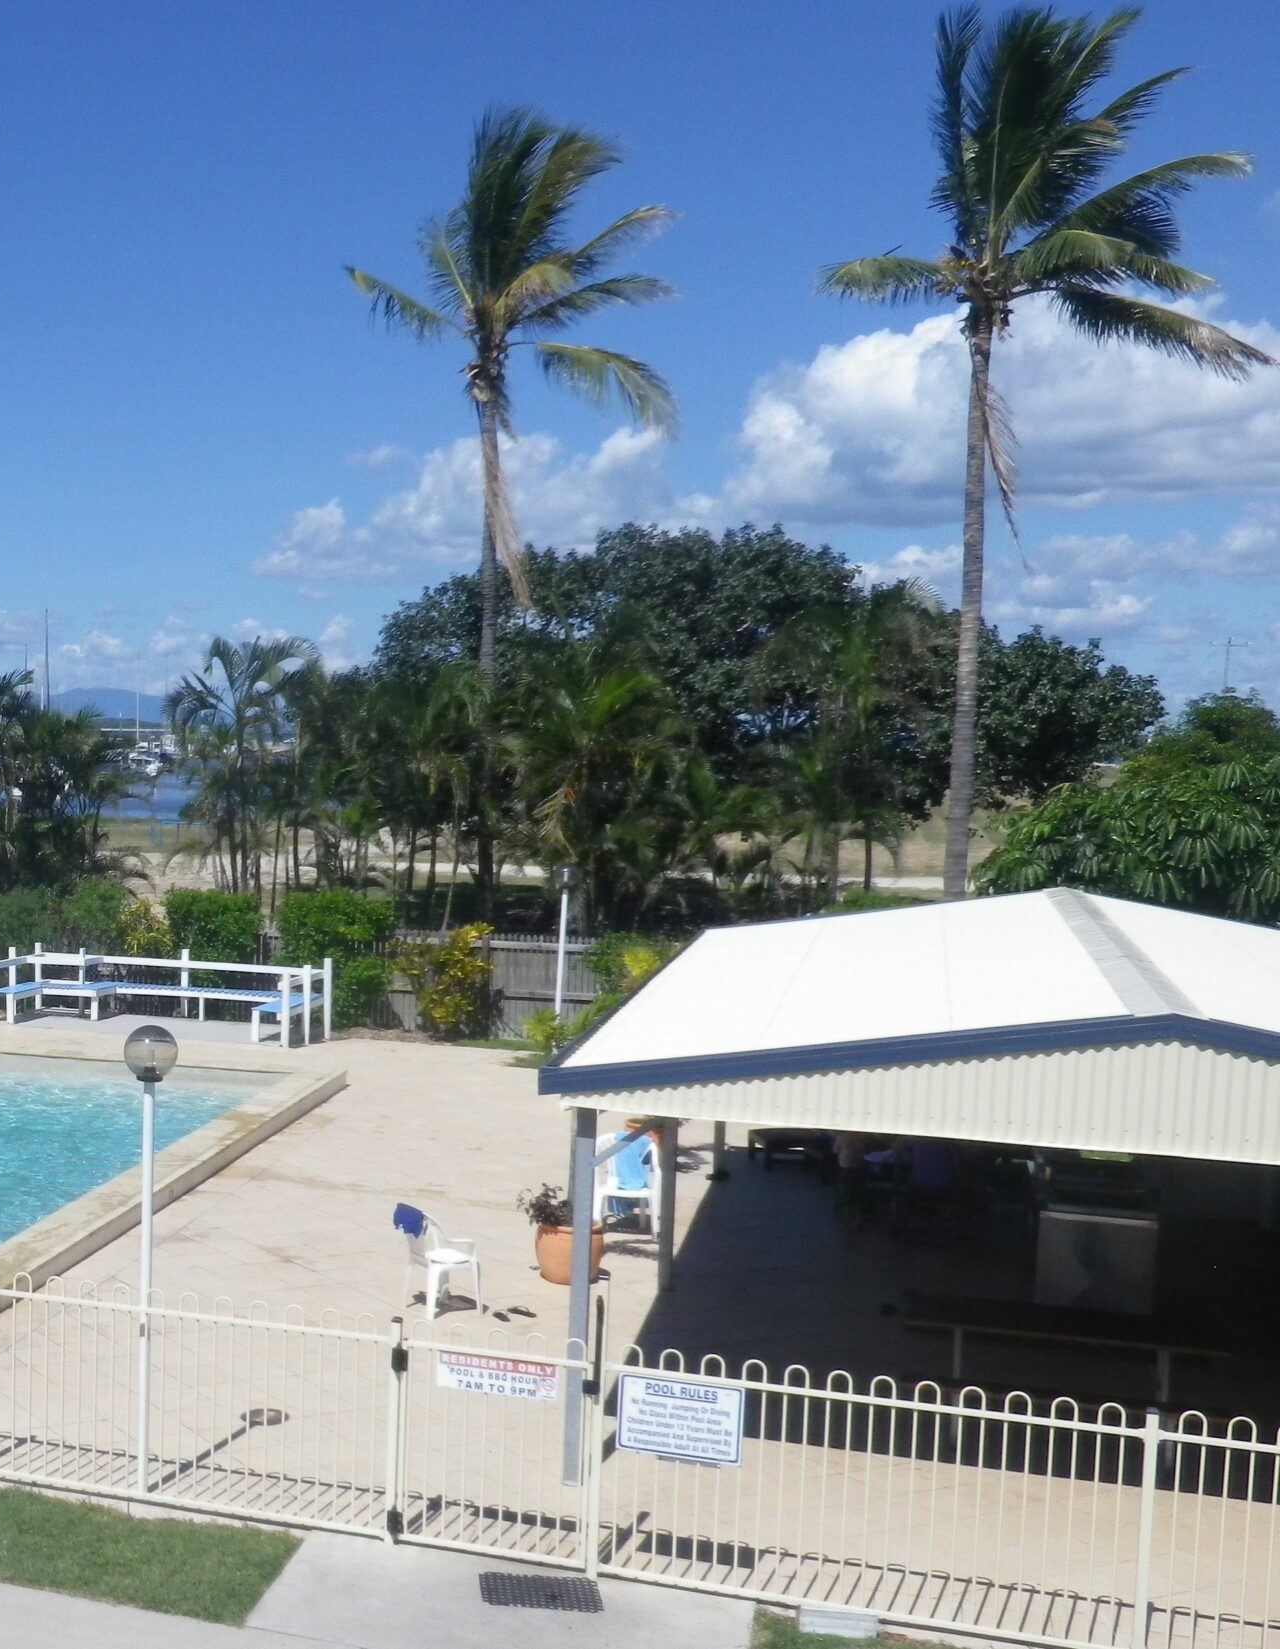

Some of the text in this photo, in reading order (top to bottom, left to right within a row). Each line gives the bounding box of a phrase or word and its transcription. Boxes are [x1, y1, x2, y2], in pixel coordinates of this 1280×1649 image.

[442, 1353, 552, 1375] RESIDENTS ONLY
[450, 1367, 474, 1377] POOL
[488, 1372, 507, 1381] BBQ
[457, 1380, 536, 1397] 7AM TO 9PM
[645, 1382, 718, 1400] POOL RULES
